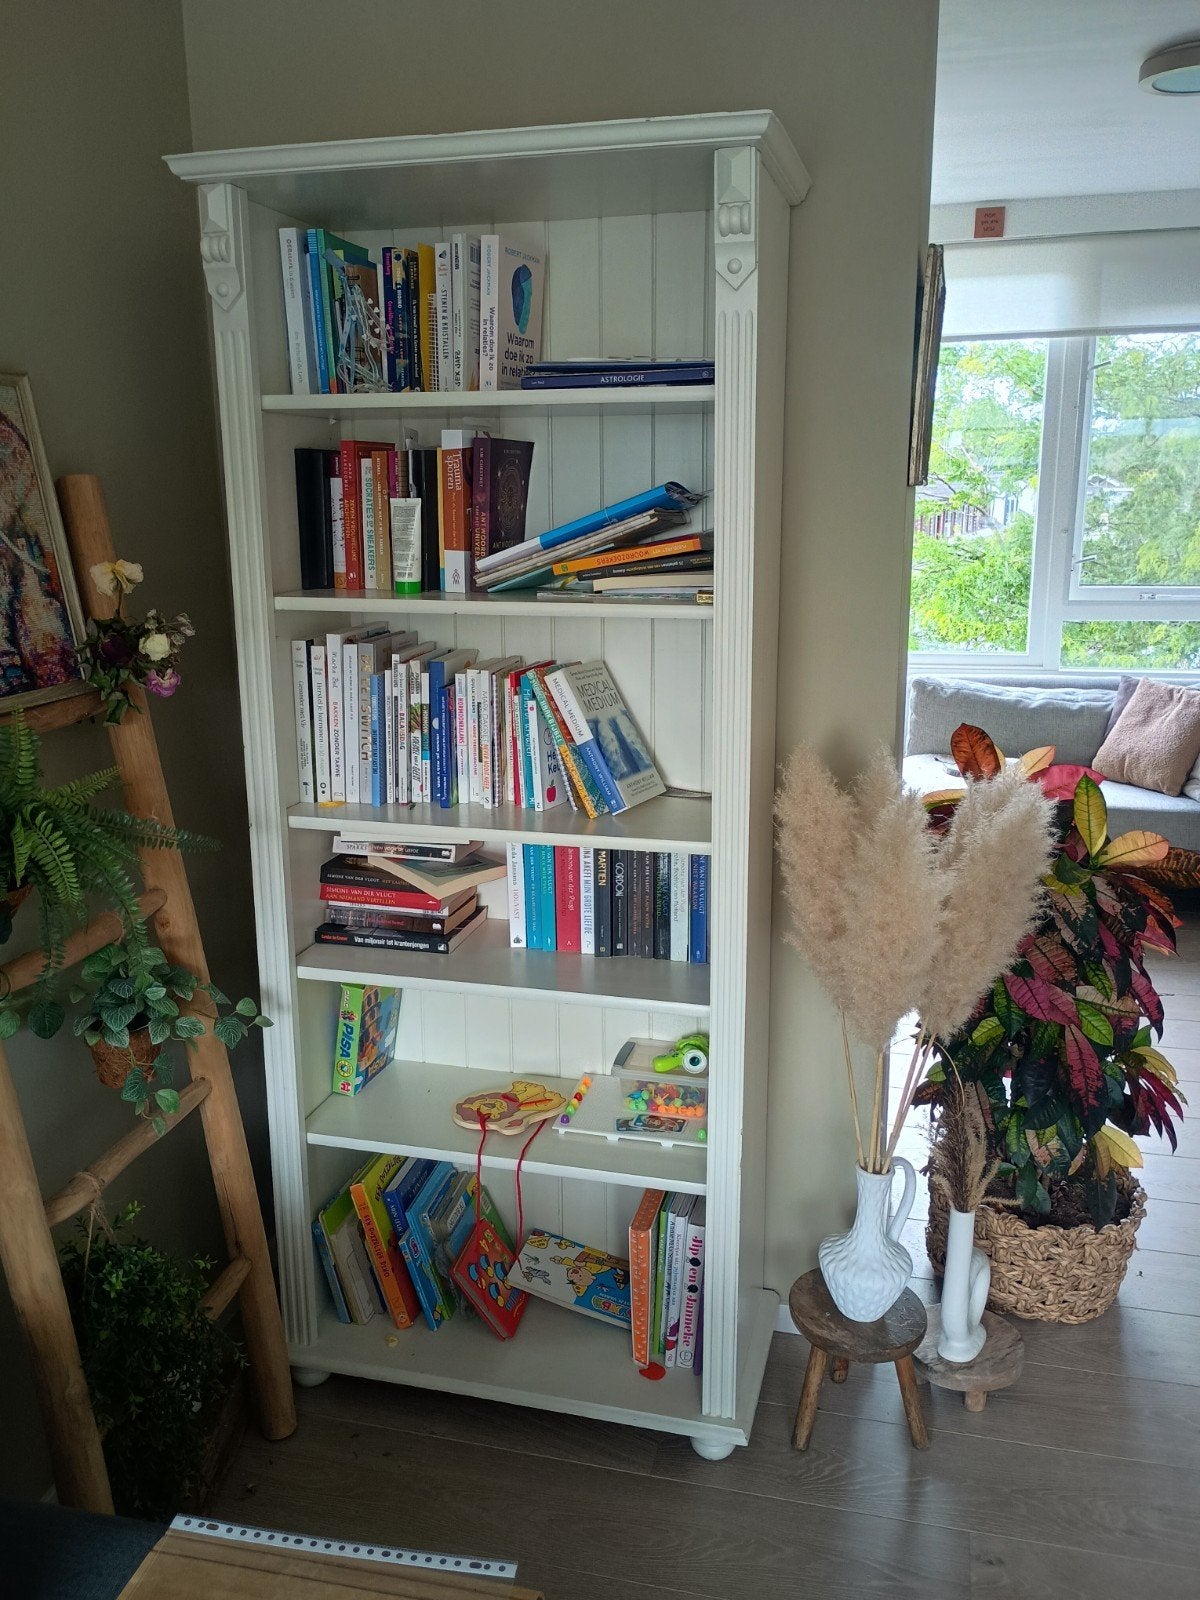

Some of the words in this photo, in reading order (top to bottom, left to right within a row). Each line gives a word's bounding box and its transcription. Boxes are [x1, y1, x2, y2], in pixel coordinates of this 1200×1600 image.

[505, 247, 522, 259] ROBERT
[507, 332, 534, 349] Waarom
[504, 348, 517, 361] doe
[519, 349, 525, 360] ik
[525, 353, 533, 364] zo
[489, 362, 494, 371] zo
[502, 362, 507, 375] in
[600, 374, 644, 383] ASTROLOGIE
[445, 455, 454, 489] sporen
[453, 451, 462, 491] Trauma
[365, 477, 373, 519] SOCRATES
[596, 550, 650, 565] WOORDZOEKERS
[576, 679, 614, 698] MEDICAL
[552, 677, 569, 709] MEDICAL
[567, 708, 584, 738] MEDIUM
[582, 692, 622, 712] MEDIUM
[318, 713, 326, 743] hormonen
[361, 679, 372, 761] EETSWITCH
[585, 747, 599, 771] ANTHONY
[598, 771, 612, 796] WILLIAM
[583, 861, 592, 878] AKEFI
[598, 851, 606, 886] MARTIEN
[615, 862, 624, 897] GORDON
[326, 886, 349, 894] SIMONE
[375, 890, 396, 898] VLUGT
[584, 894, 592, 914] GROTE
[584, 915, 592, 934] LIEFDE
[364, 937, 385, 945] miljonair
[689, 1236, 703, 1255] Jip
[688, 1267, 698, 1283] en
[682, 1294, 698, 1348] Janneke
